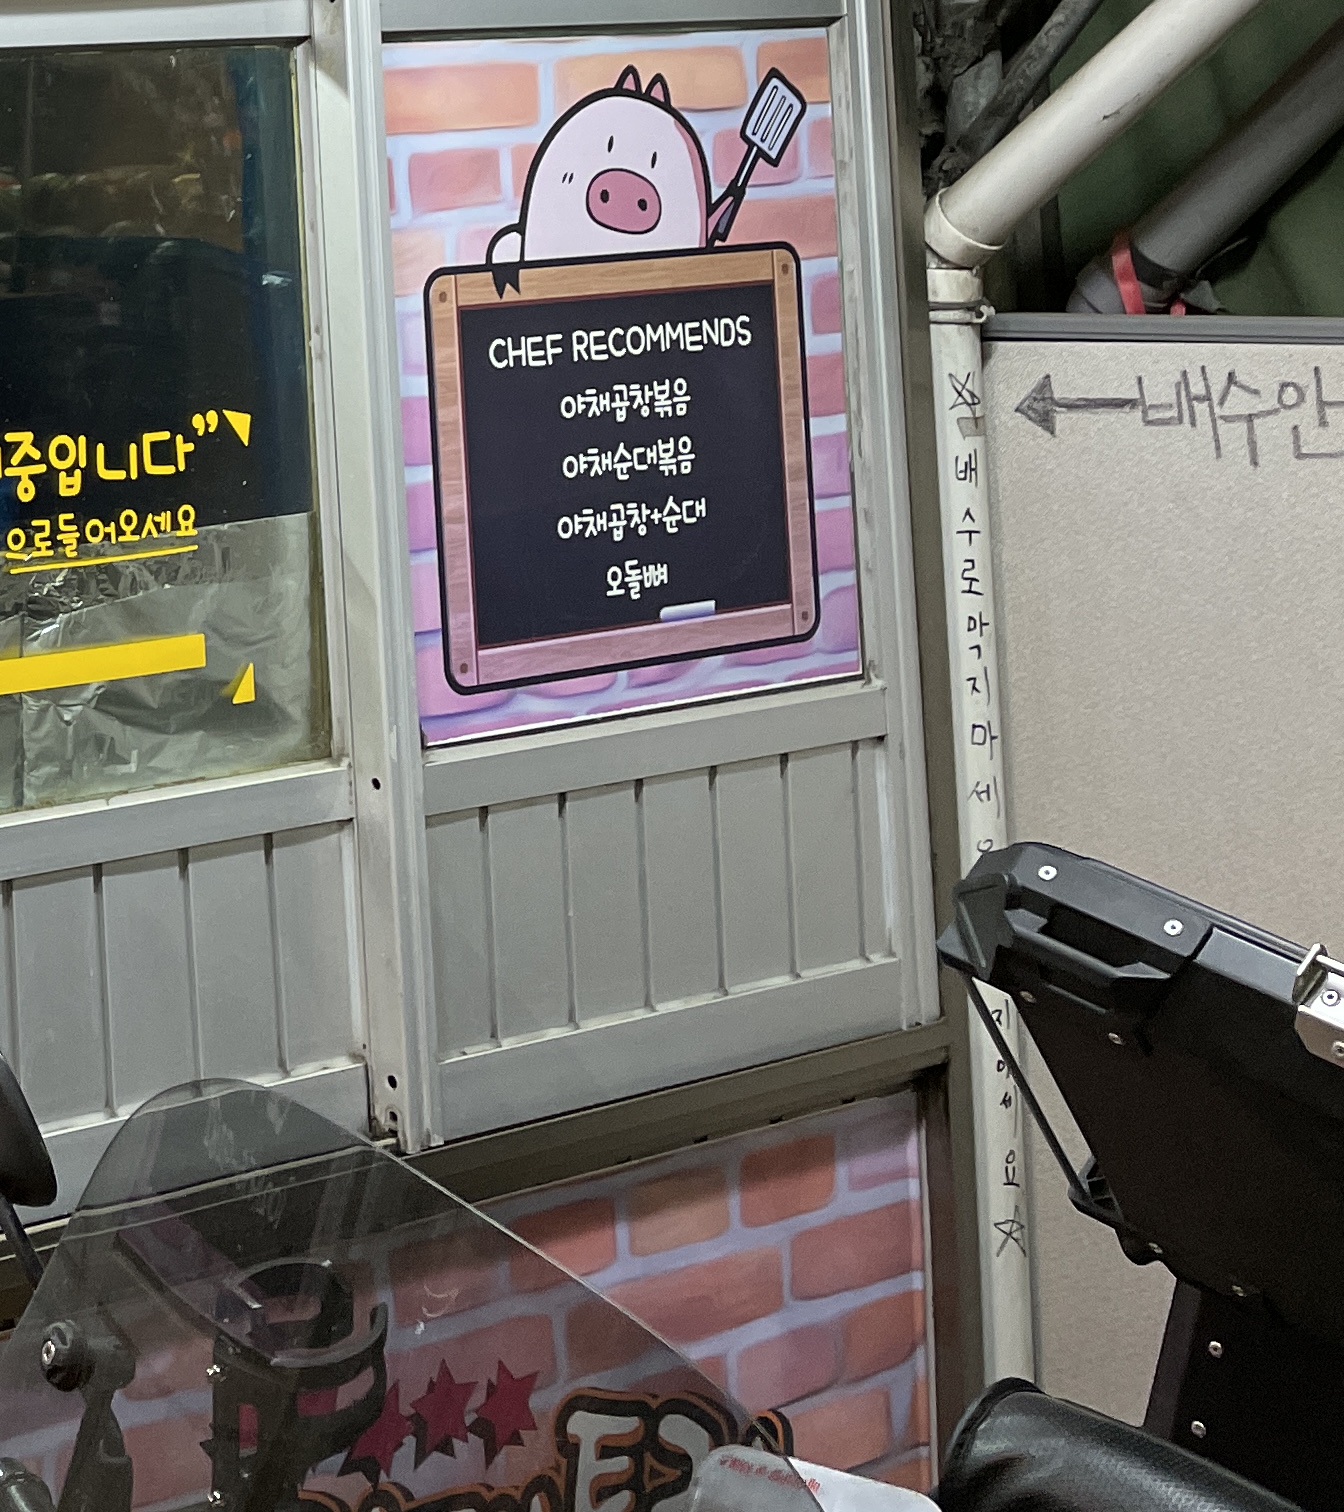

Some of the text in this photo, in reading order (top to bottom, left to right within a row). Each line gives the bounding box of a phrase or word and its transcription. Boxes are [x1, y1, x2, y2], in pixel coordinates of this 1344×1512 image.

[488, 315, 752, 370] CHEF RECOMMENDS
[560, 377, 692, 423] 야채곱창볶음
[562, 435, 696, 481] 야채순대볶음
[557, 495, 707, 542] 야채곱창+순대
[606, 559, 669, 600] 오돌뼈
